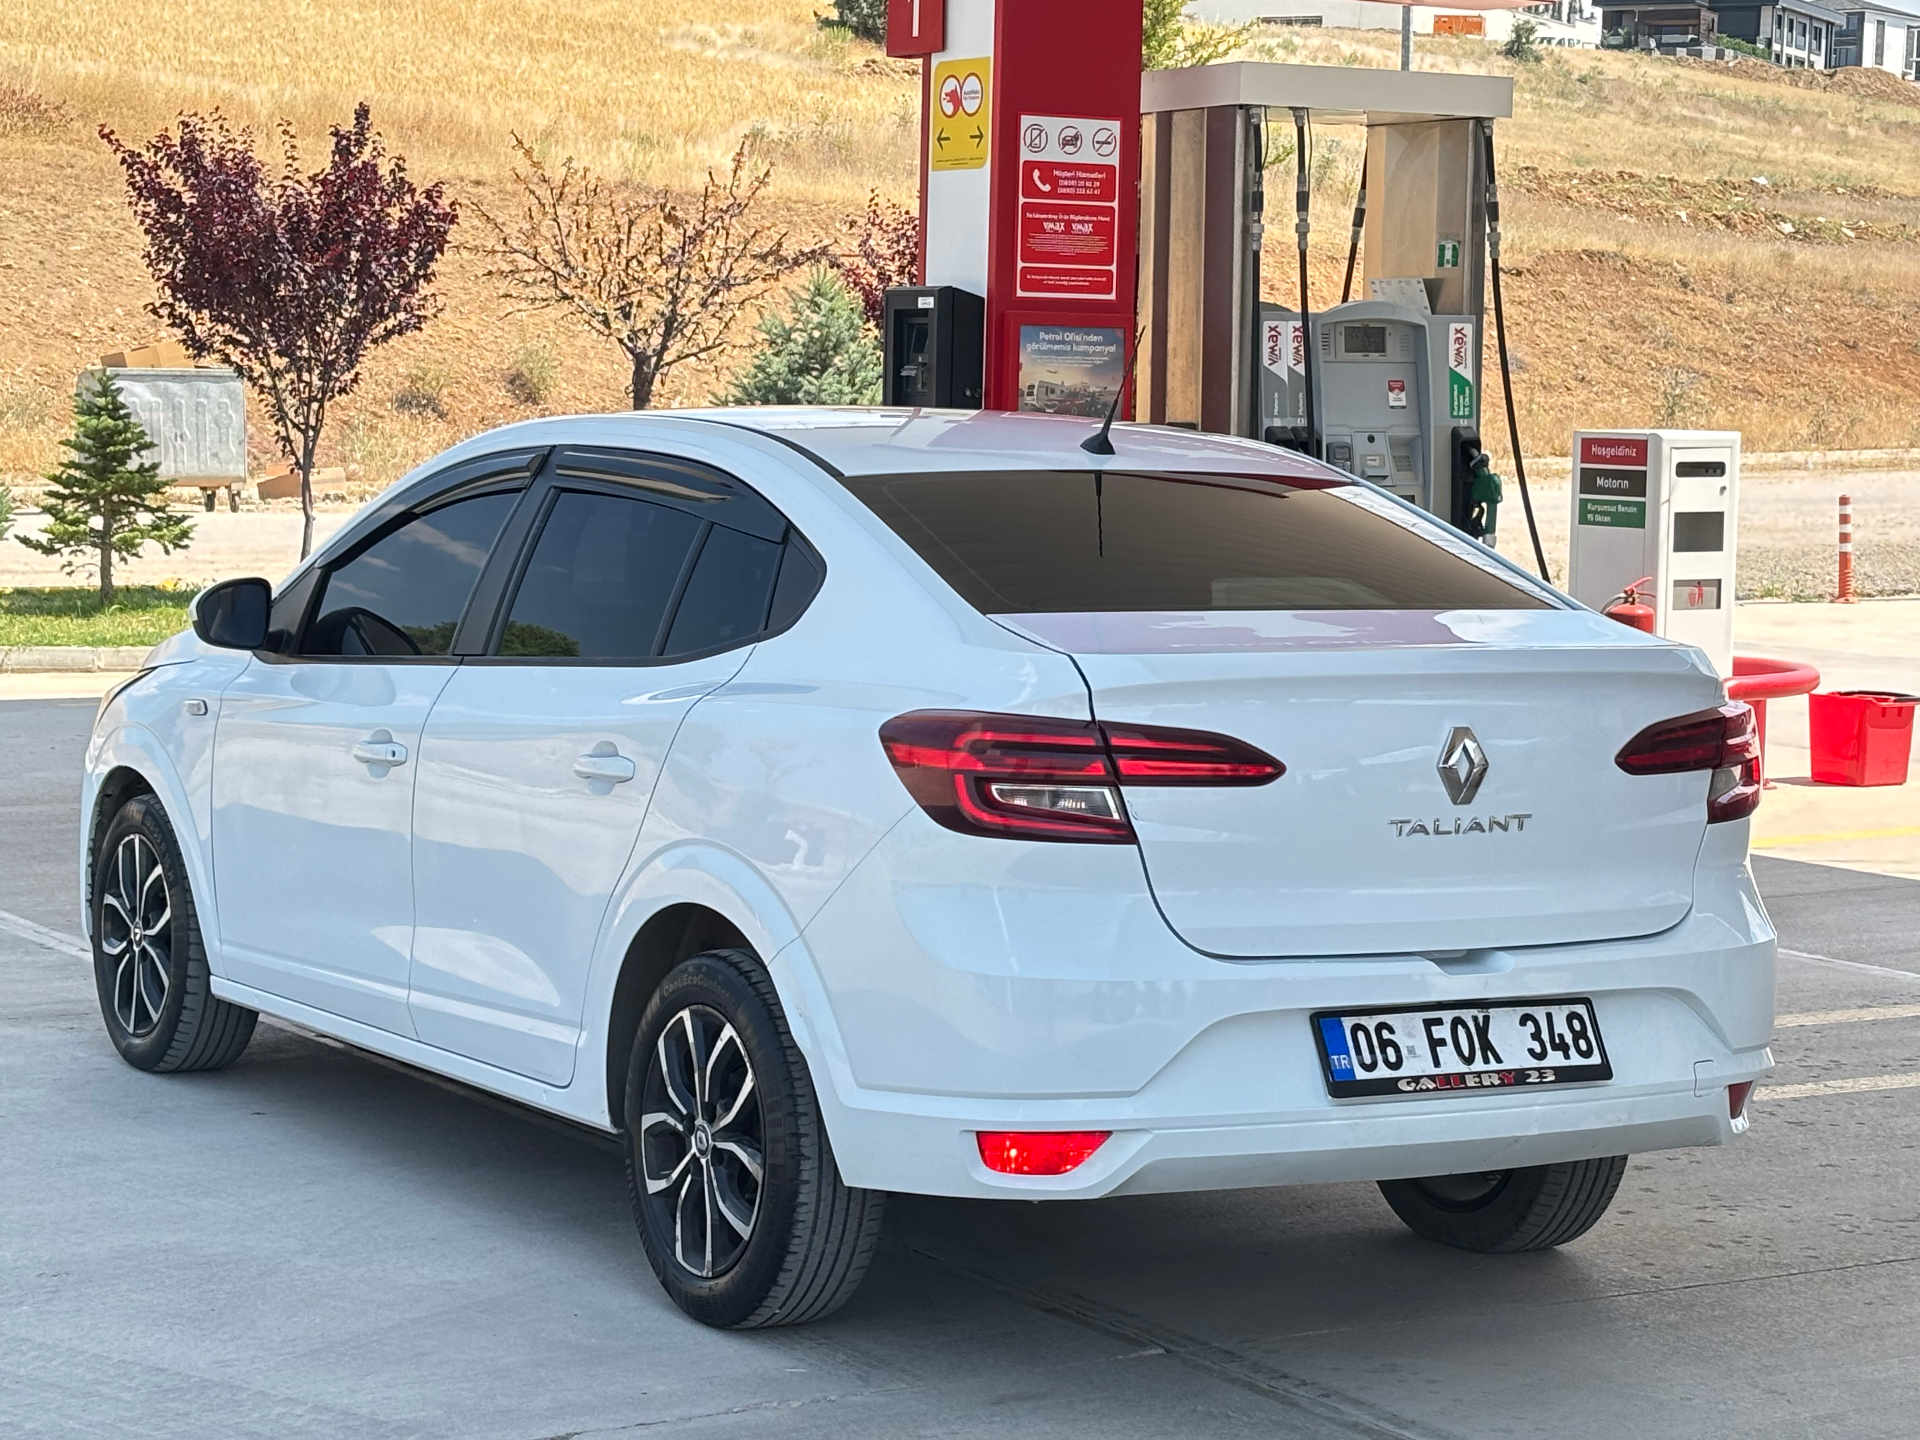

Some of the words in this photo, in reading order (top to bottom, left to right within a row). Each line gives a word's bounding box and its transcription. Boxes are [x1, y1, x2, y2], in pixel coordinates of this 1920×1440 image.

[1039, 332, 1062, 341] Petrol
[1064, 332, 1103, 342] Ofisi'nden
[1617, 504, 1637, 513] Benzin
[1387, 814, 1532, 837] TALIANT
[1350, 1021, 1404, 1073] 06
[1422, 1014, 1504, 1069] FOK
[1519, 1011, 1594, 1062] 348
[1331, 1054, 1351, 1070] TR
[1397, 1071, 1516, 1092] GALLERY
[1525, 1069, 1556, 1083] 23
